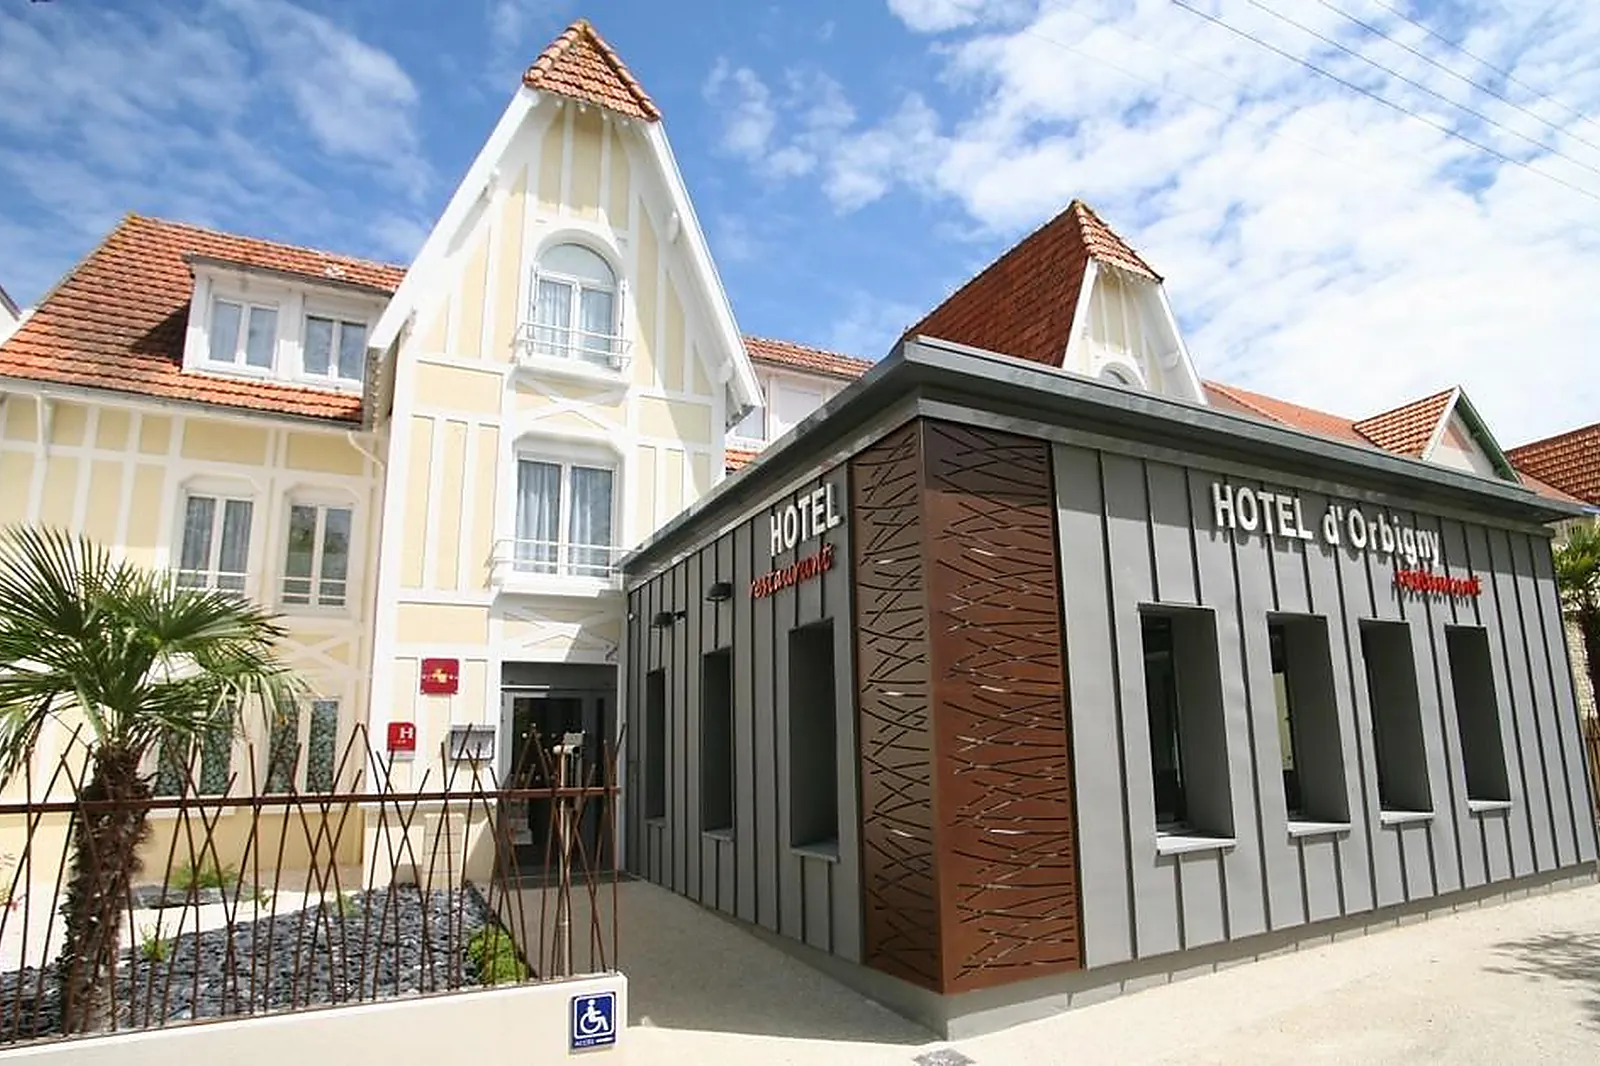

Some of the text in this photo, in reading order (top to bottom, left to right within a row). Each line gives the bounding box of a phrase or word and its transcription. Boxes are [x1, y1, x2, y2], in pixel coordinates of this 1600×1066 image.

[770, 482, 841, 557] HOTEL
[1212, 482, 1440, 567] HOTEL d'Orbigny
[400, 727, 414, 739] H
